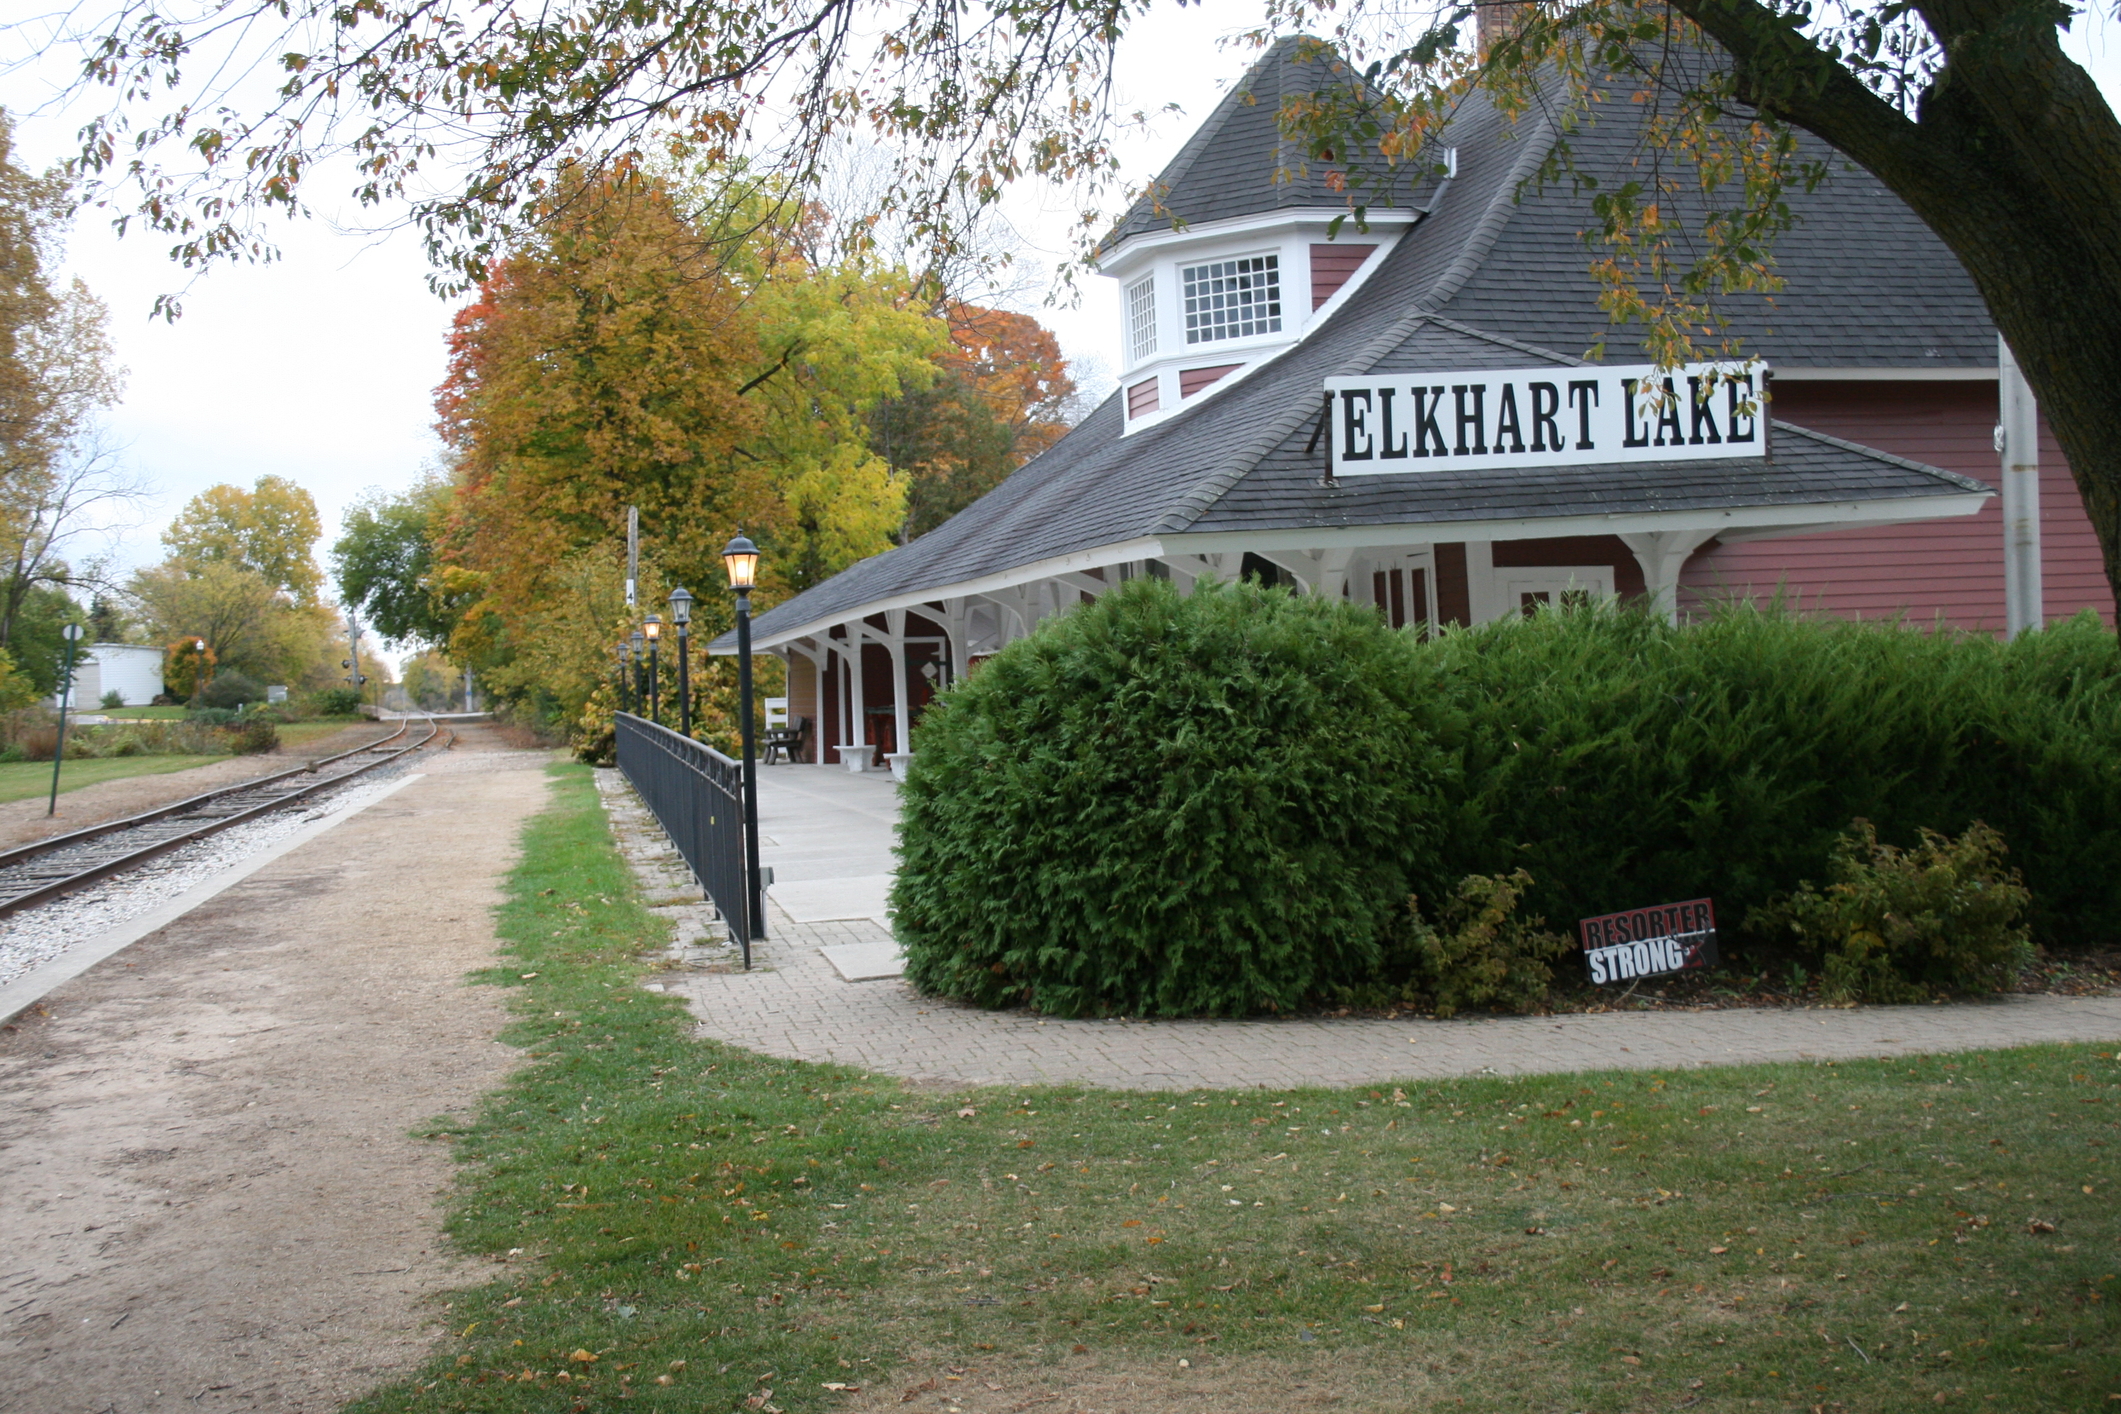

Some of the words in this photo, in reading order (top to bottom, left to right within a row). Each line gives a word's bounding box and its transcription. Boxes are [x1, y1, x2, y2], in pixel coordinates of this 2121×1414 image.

[1340, 380, 1599, 462] ELKHART
[1621, 374, 1755, 448] LAKE
[1585, 902, 1711, 950] RESORTER
[1589, 938, 1684, 985] STRONG
